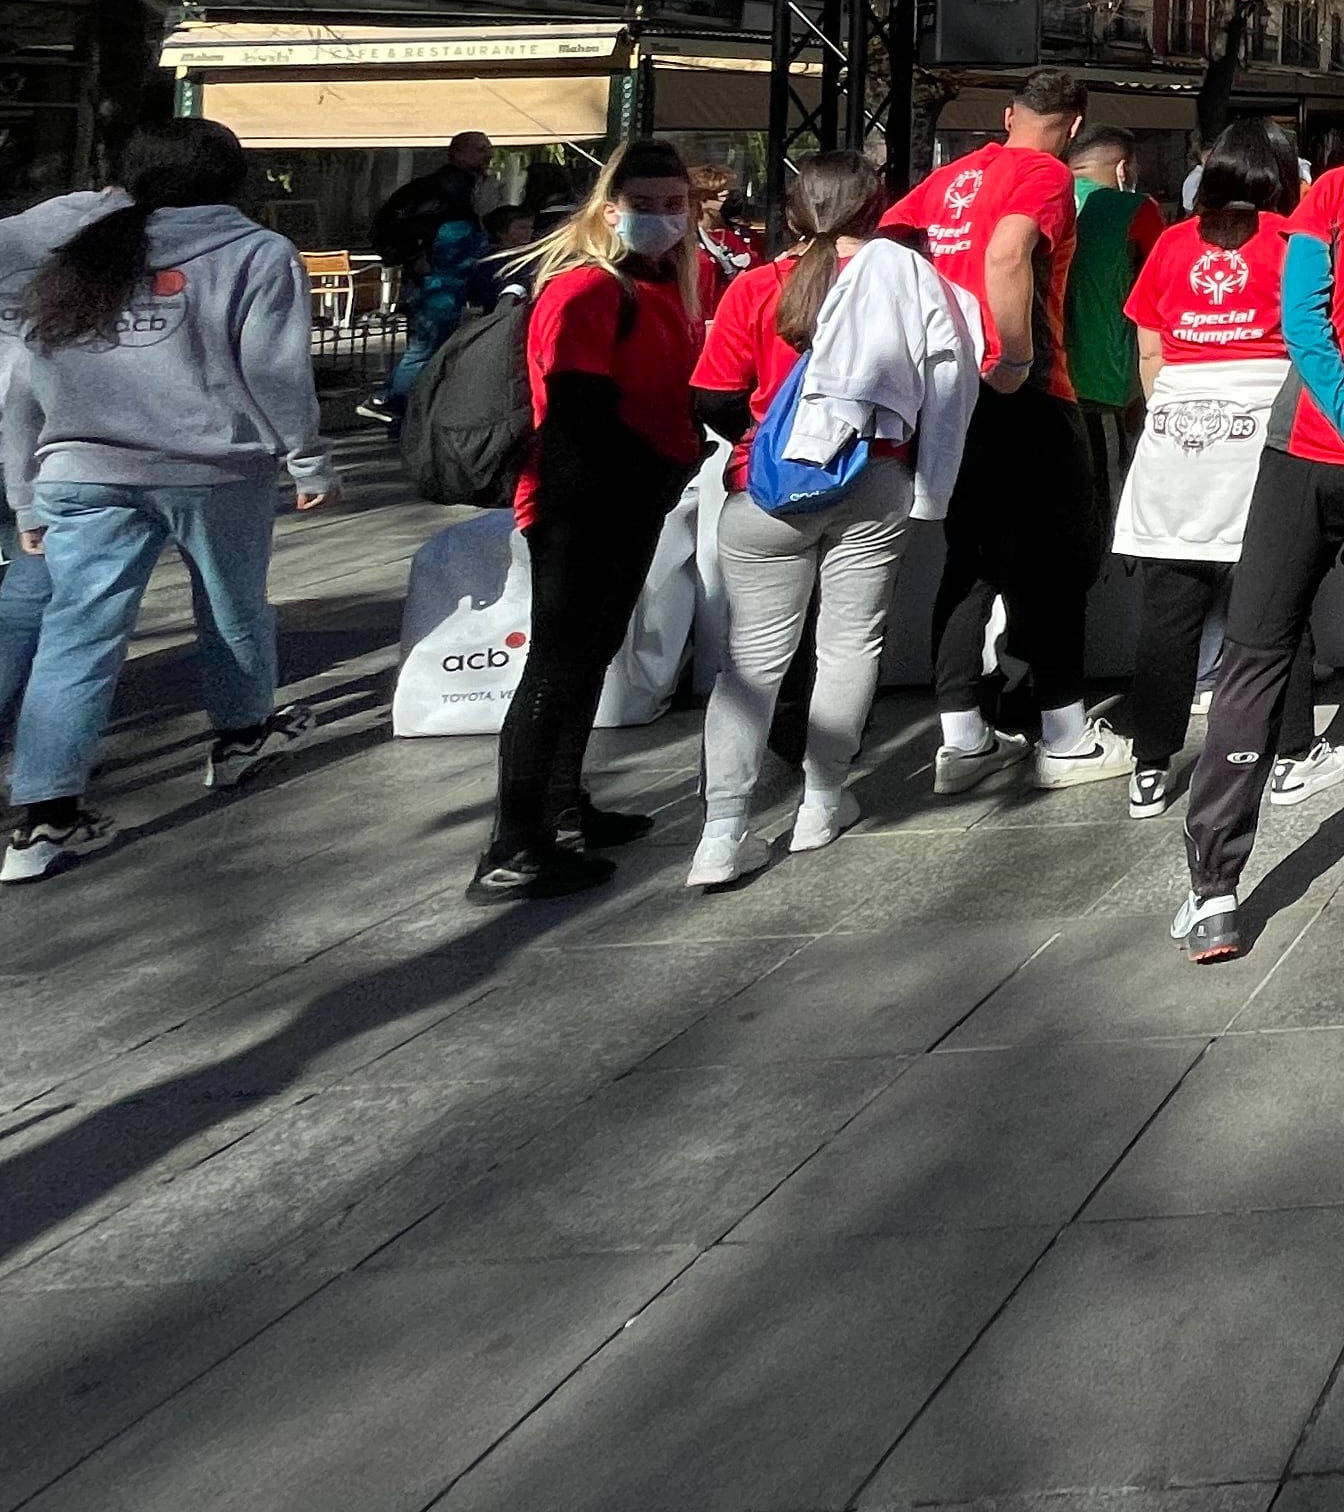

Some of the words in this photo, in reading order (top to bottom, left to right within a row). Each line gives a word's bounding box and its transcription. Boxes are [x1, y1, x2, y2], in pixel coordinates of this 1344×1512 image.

[404, 44, 540, 57] RESTAURANTE
[1180, 308, 1257, 328] Special
[1231, 418, 1255, 437] 83
[442, 648, 510, 672] acb
[442, 691, 496, 704] TOYOTA,
